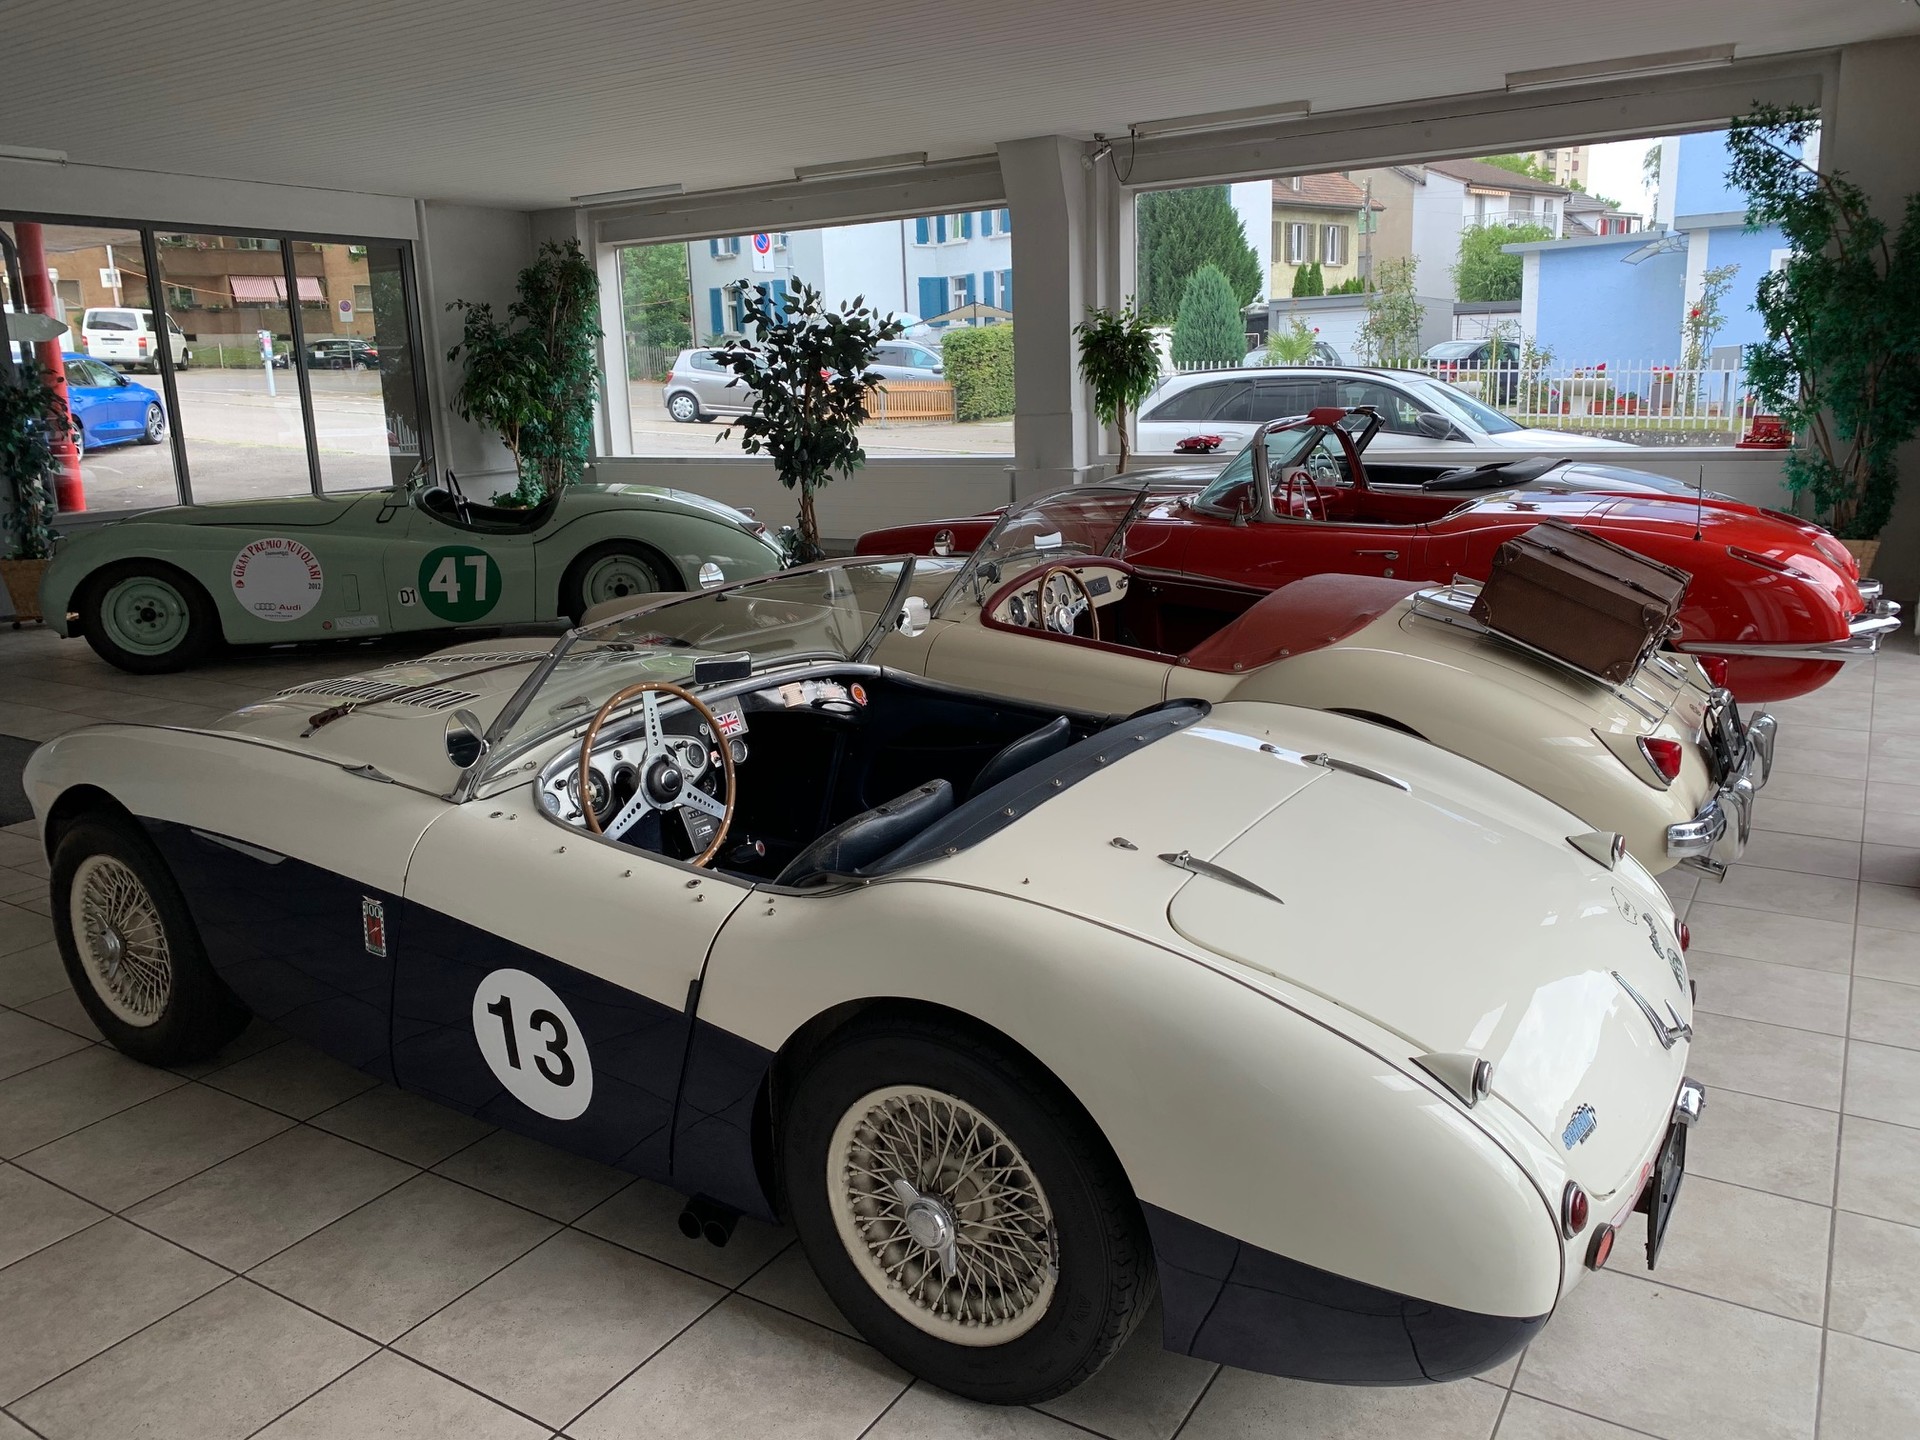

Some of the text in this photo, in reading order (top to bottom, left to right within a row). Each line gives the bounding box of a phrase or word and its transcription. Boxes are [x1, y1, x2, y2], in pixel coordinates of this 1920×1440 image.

[233, 539, 322, 580] GRAN PREMIO NUVOLARI
[428, 555, 488, 603] 47
[308, 582, 321, 590] 2012
[400, 589, 417, 604] D1
[487, 994, 575, 1088] 13
